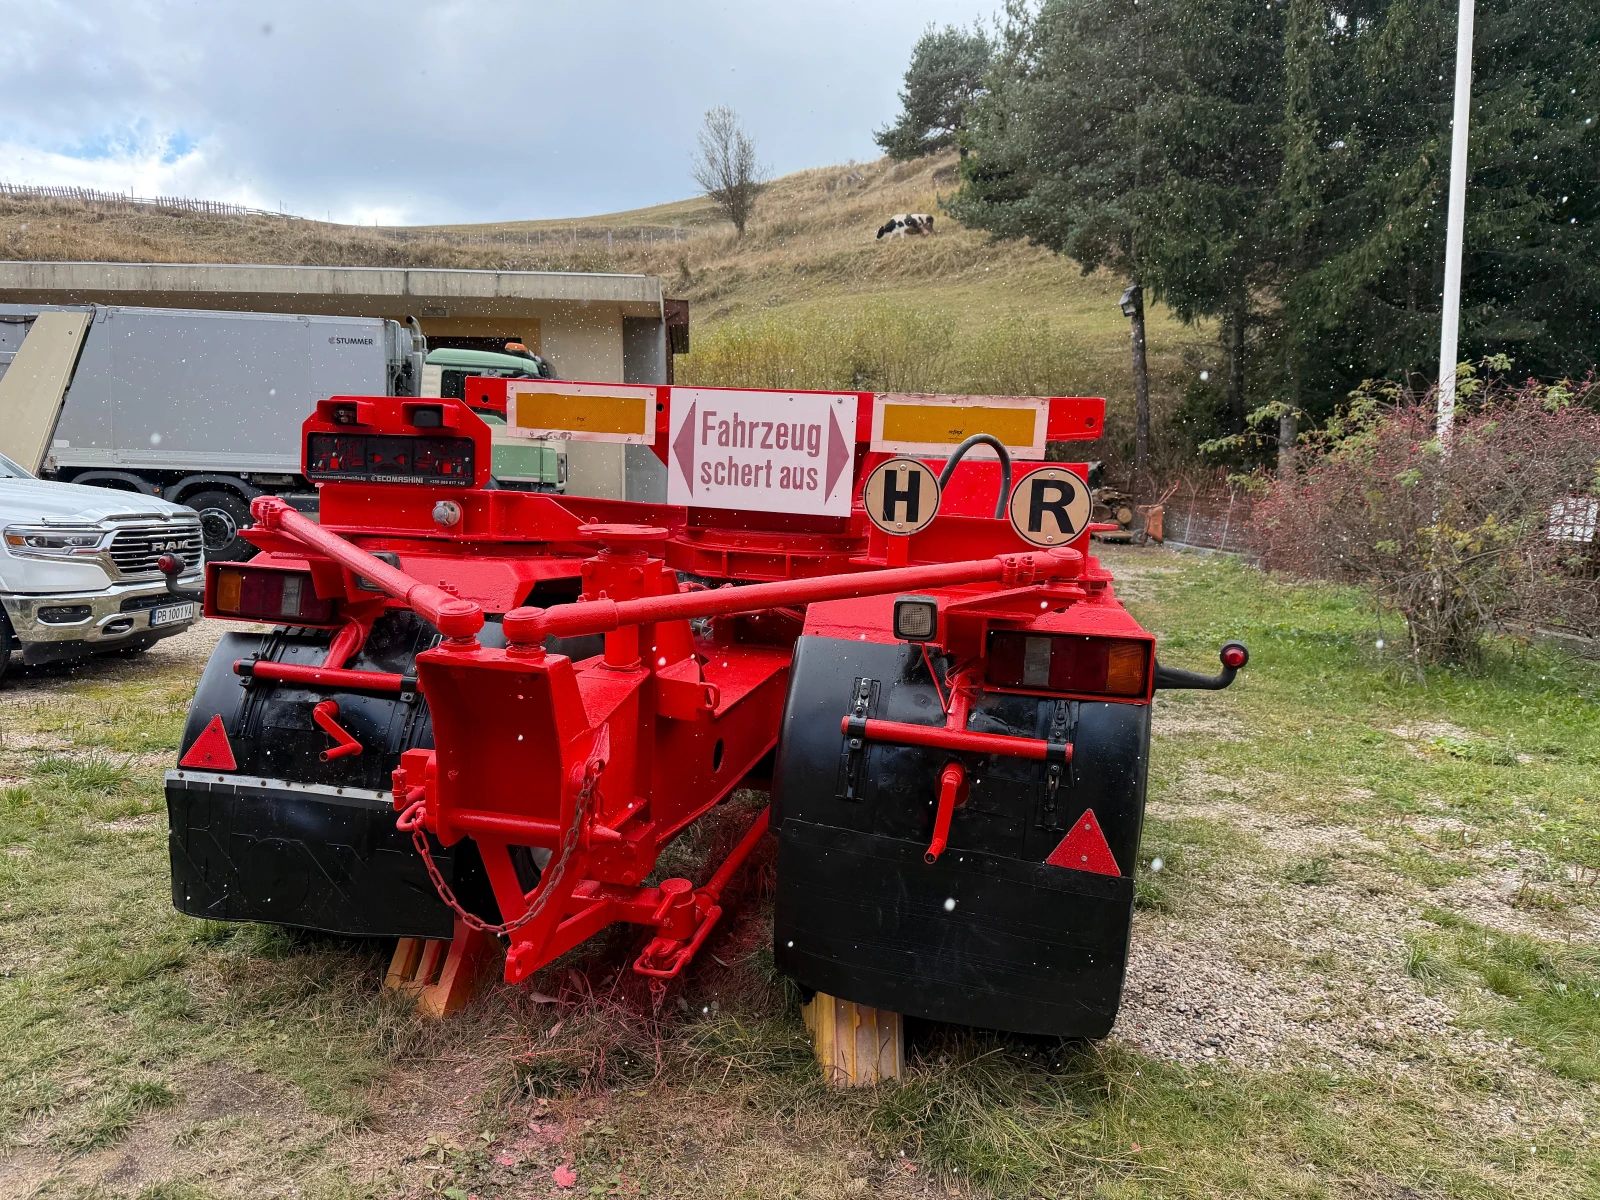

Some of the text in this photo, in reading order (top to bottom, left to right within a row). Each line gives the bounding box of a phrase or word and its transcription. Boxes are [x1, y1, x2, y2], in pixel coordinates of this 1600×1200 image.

[336, 337, 374, 345] STUMMER
[701, 410, 822, 458] Fahrzeug
[377, 475, 424, 484] ECOMASHINI
[700, 455, 819, 491] schert aus
[882, 469, 921, 523] H
[1027, 478, 1076, 535] R
[151, 540, 189, 552] RAM
[156, 609, 167, 623] PB
[168, 606, 184, 621] 1001
